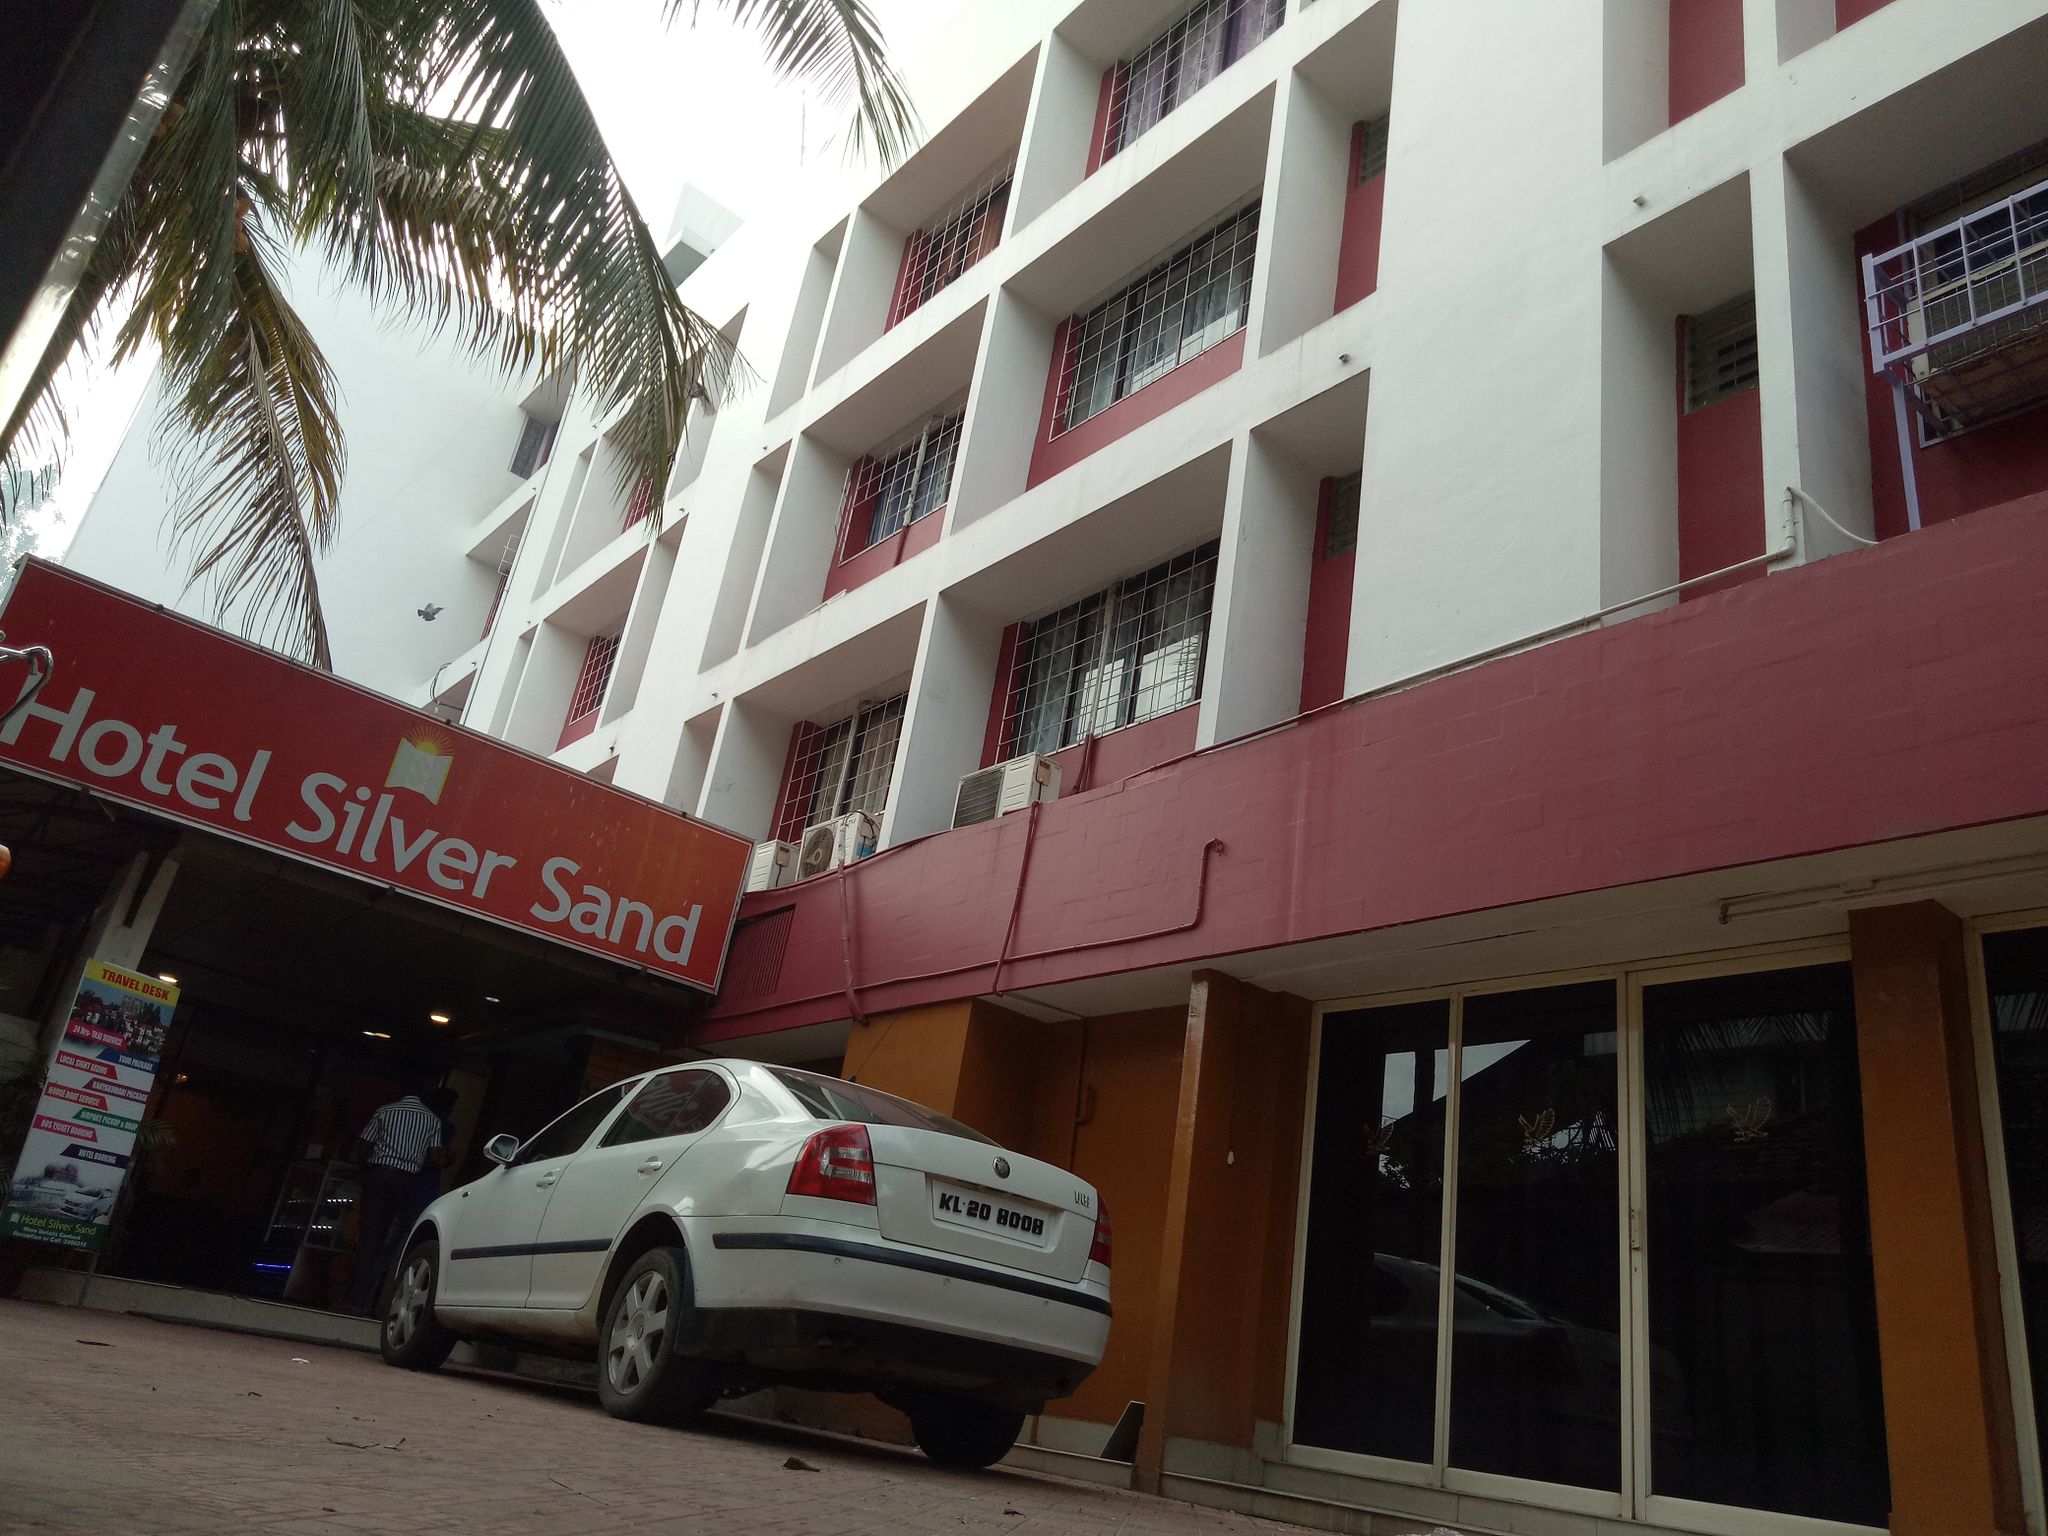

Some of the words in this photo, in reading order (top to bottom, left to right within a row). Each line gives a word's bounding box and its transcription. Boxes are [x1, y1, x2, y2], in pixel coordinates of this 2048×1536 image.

[0, 671, 272, 822] Hotel
[285, 772, 518, 899] Silver
[530, 857, 702, 966] Sand
[102, 968, 140, 991] TRAVEL
[142, 982, 170, 1000] DESK
[102, 1032, 122, 1046] SERVICE
[132, 1058, 154, 1071] PACKAGE
[80, 1094, 100, 1106] SERVICE
[938, 1192, 963, 1214] KL
[966, 1199, 992, 1221] 20
[21, 1214, 46, 1227] Hotel
[49, 1219, 72, 1231] Silver
[76, 1224, 96, 1235] Sand
